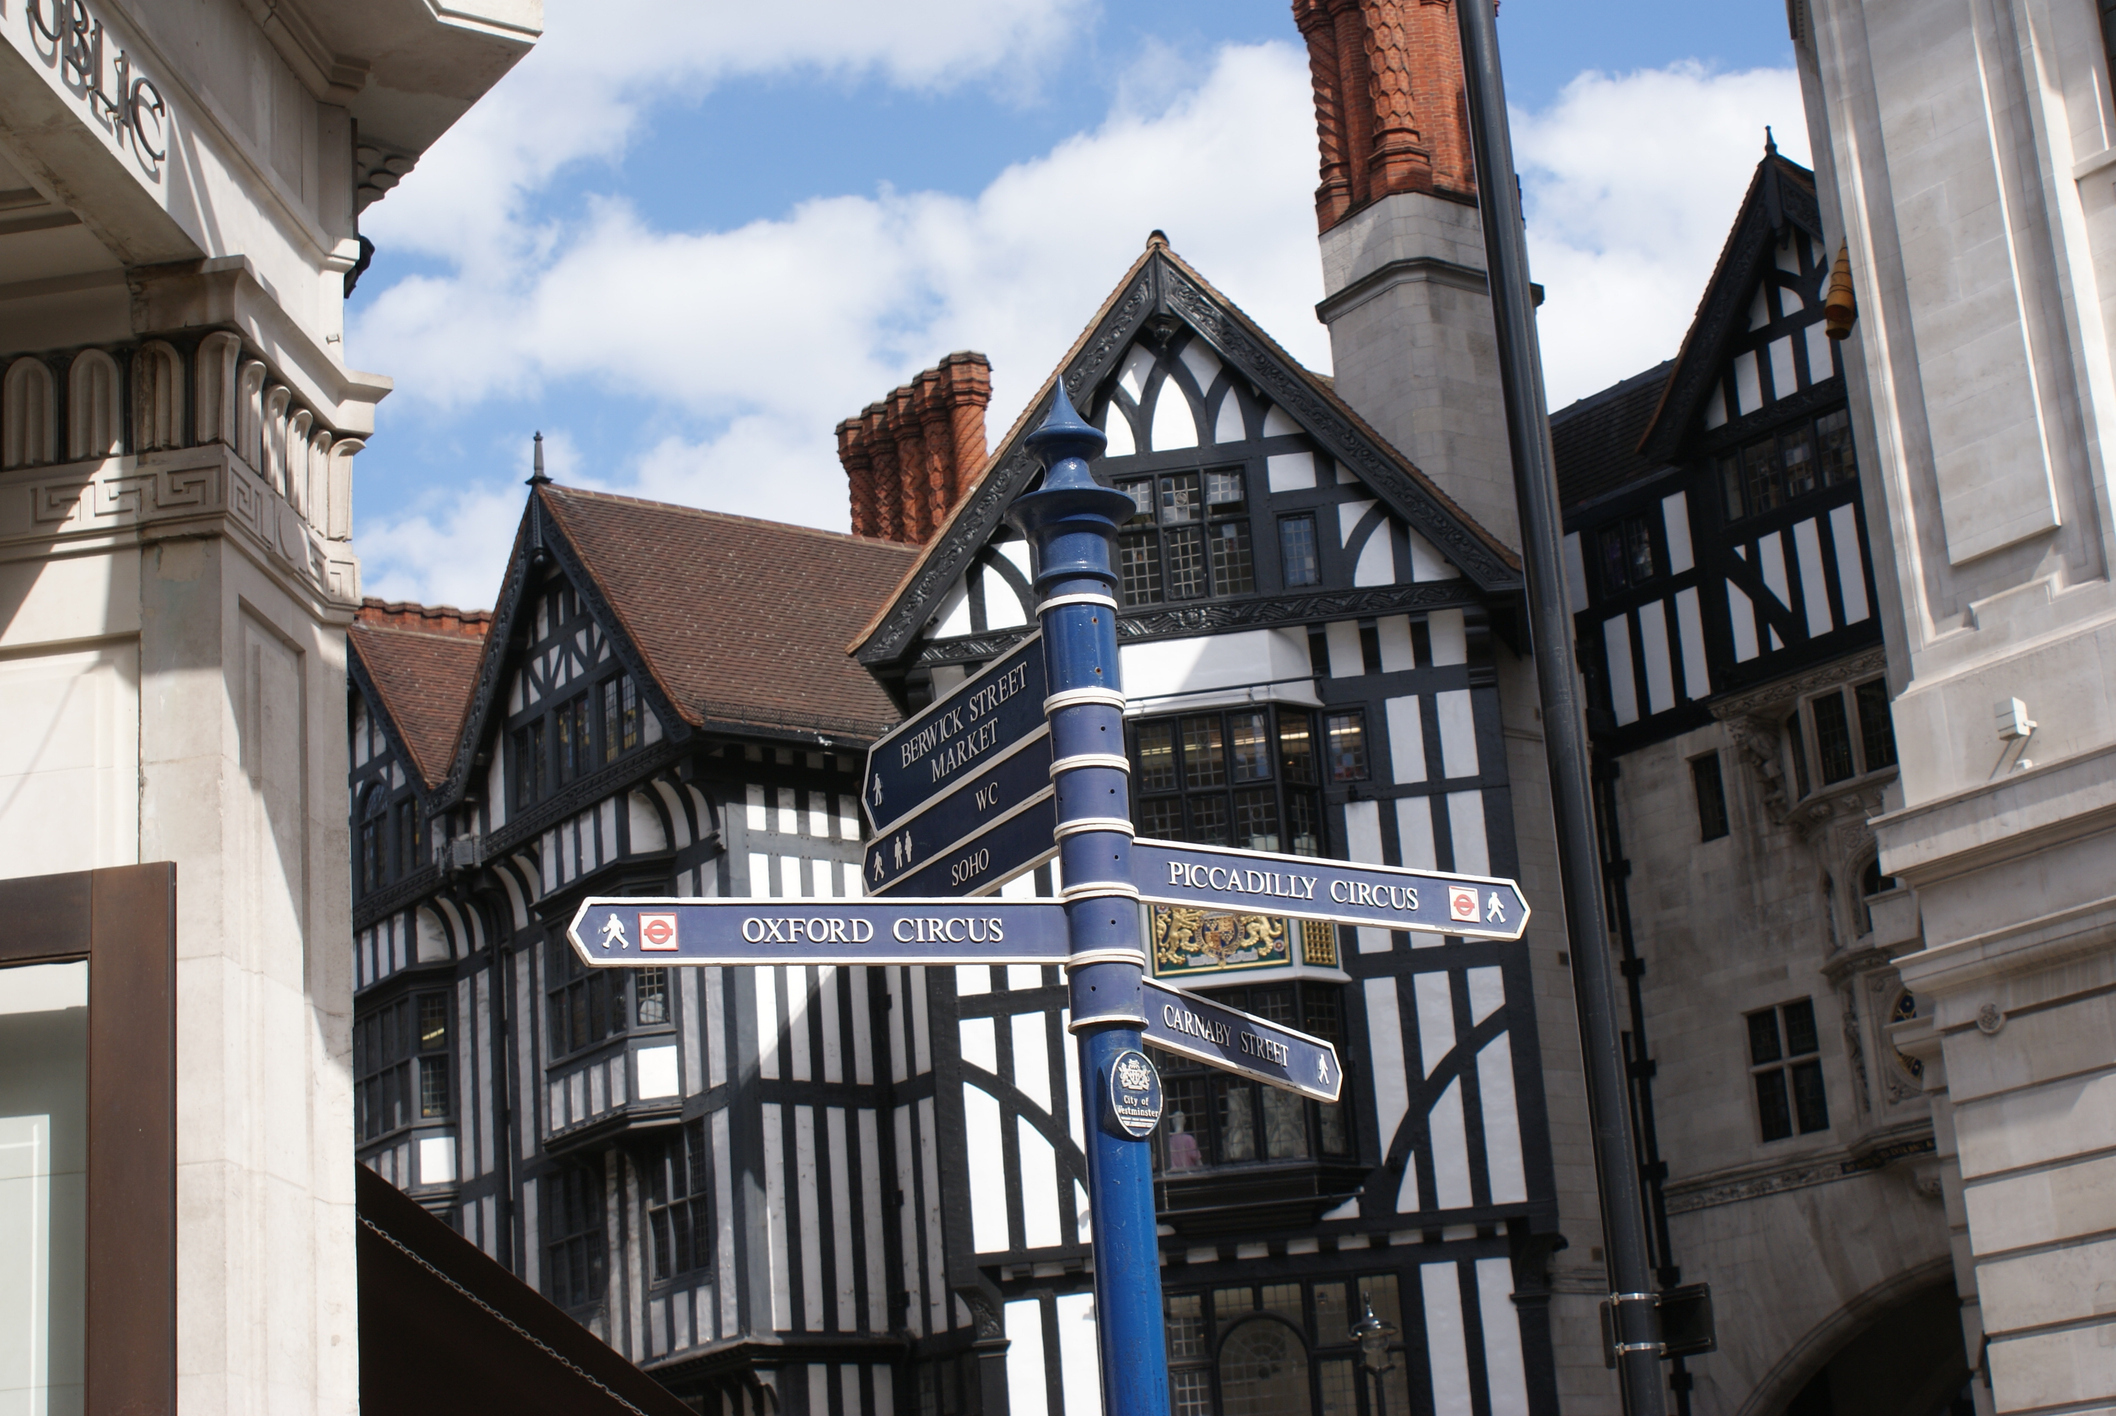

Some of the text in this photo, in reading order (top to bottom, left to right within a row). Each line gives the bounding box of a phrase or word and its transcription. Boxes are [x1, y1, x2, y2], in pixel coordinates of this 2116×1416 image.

[901, 661, 1027, 769] BERWICK STREET
[930, 717, 998, 783] MARKET
[975, 782, 998, 812] WC
[951, 848, 990, 887] SOHO
[1168, 861, 1419, 911] PICCADILLY CIRCUS
[741, 917, 1004, 944] OXFORD CIRCUS
[1163, 1004, 1289, 1068] CARNABY STREET
[1123, 1094, 1149, 1107] City of
